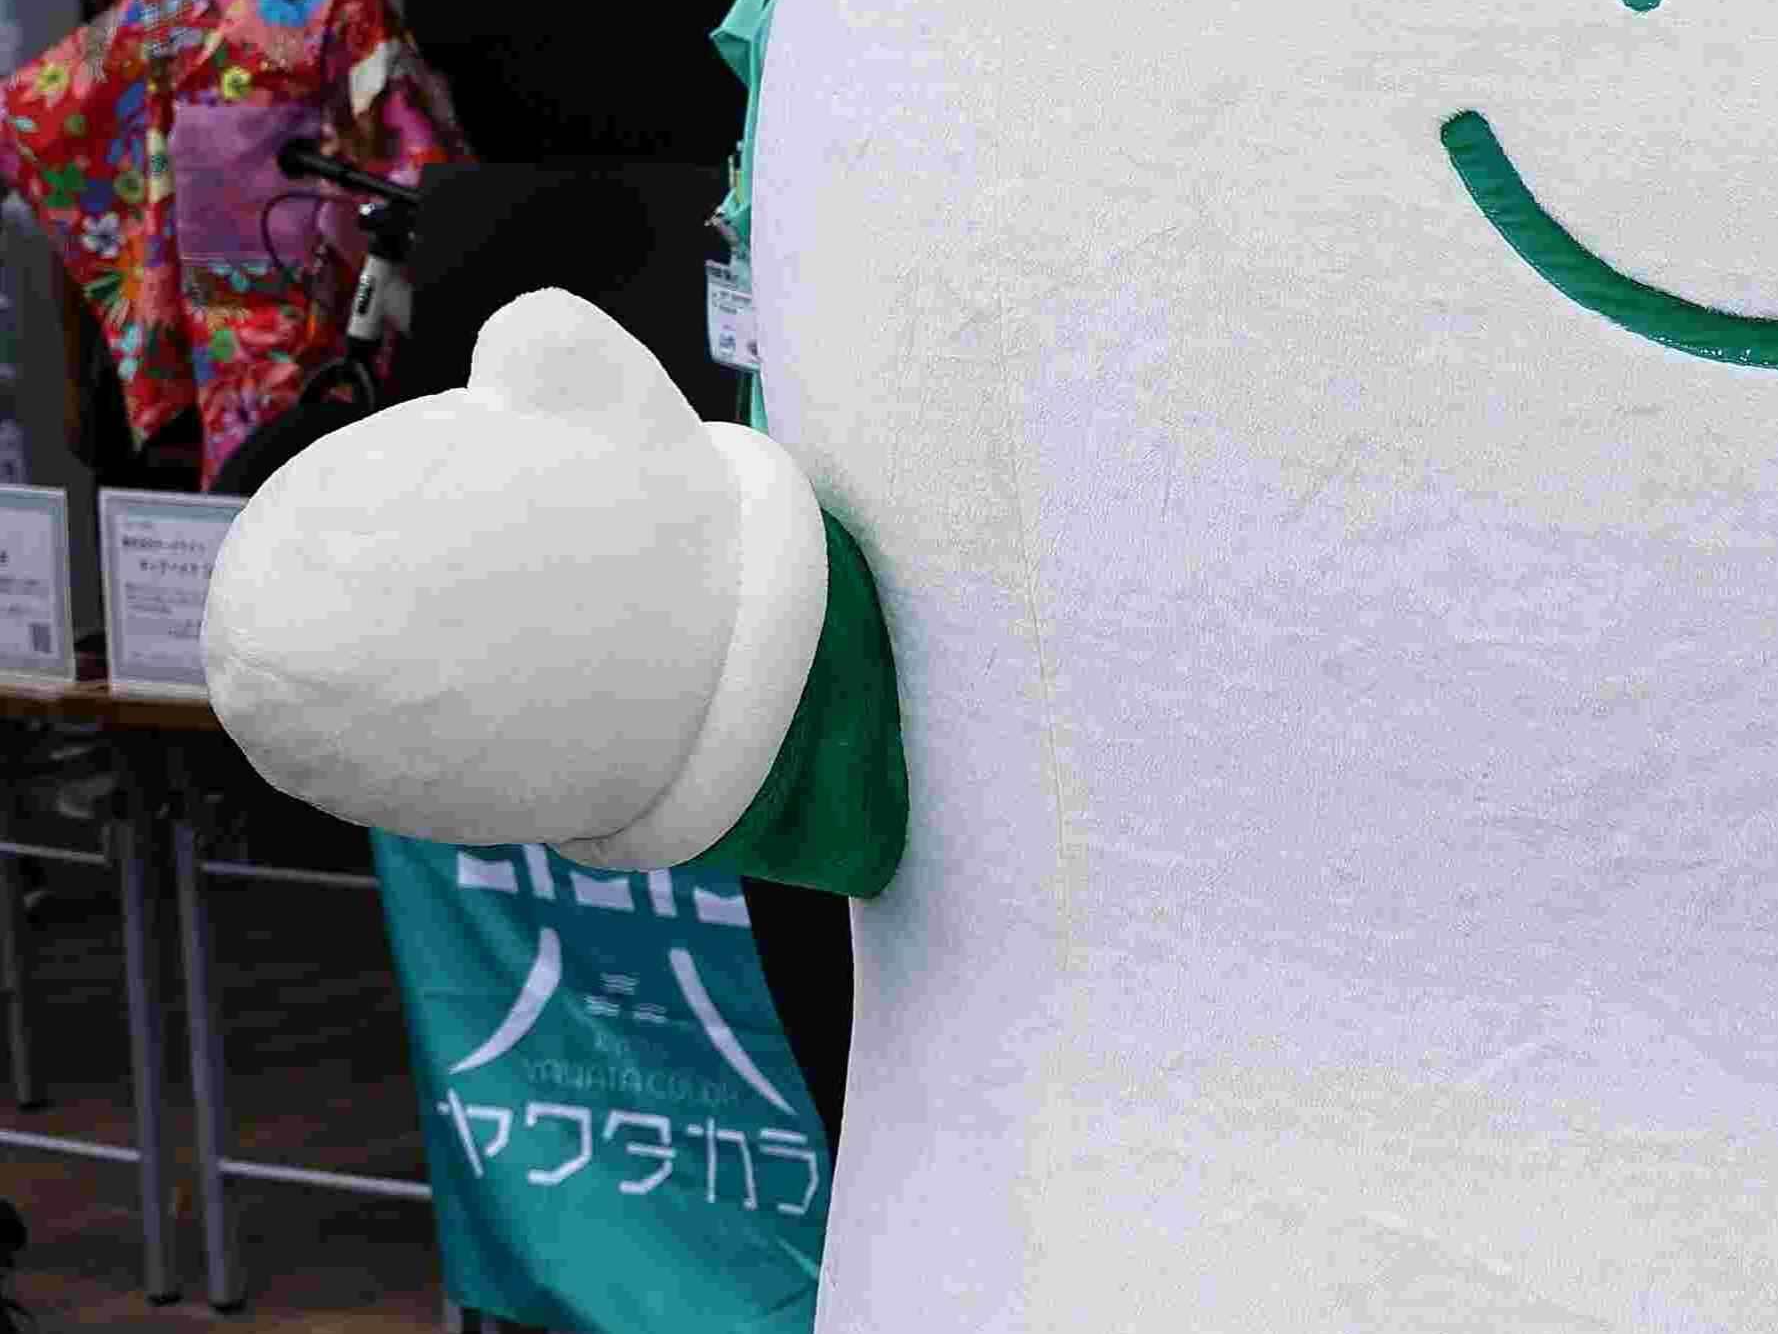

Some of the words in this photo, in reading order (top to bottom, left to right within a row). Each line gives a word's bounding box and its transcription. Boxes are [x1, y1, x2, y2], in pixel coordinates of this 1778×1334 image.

[437, 1085, 821, 1216] ヤワタカラ
